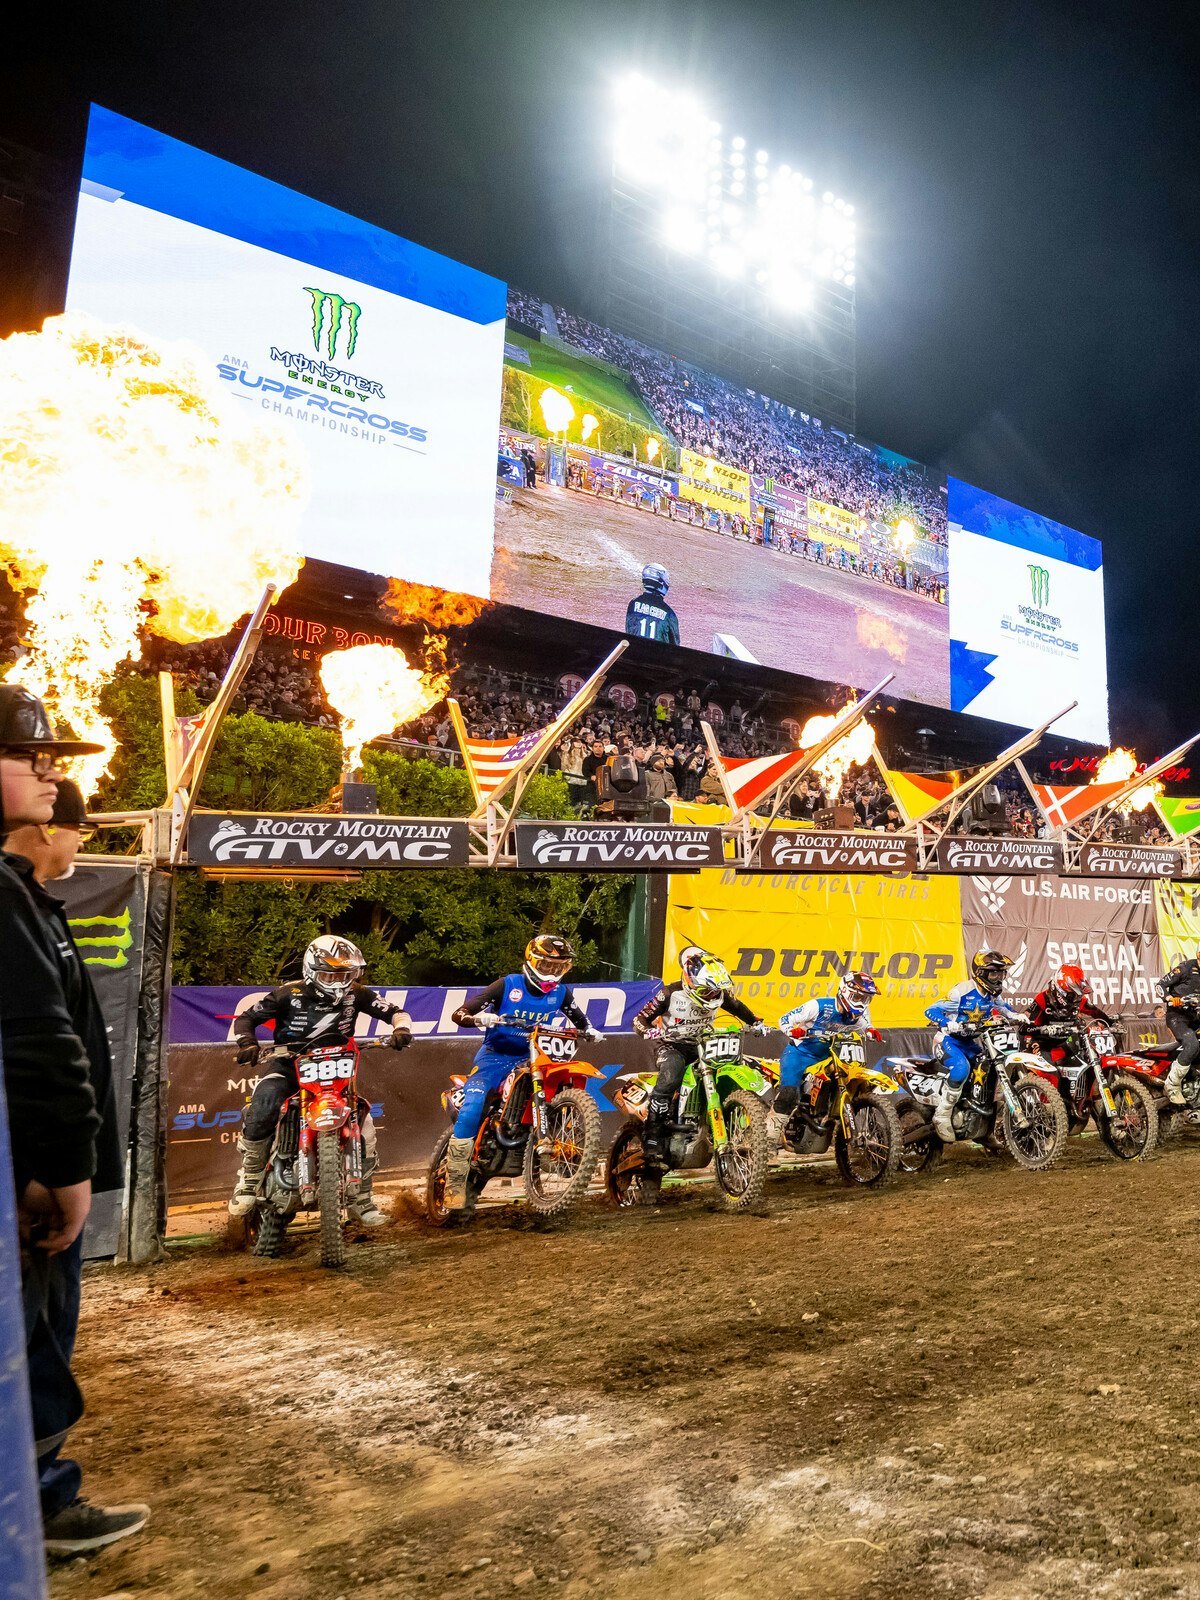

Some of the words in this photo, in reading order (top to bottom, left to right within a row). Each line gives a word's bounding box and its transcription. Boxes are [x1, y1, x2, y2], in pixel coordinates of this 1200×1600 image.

[222, 354, 249, 370] AMA
[288, 370, 370, 402] ENERGY
[216, 363, 428, 442] SUPERCROSS
[261, 398, 387, 445] CHAMPIONSHIP
[694, 459, 746, 482] DNLOP
[1001, 620, 1079, 652] SUPERCROSS
[251, 818, 331, 837] ROCKY
[334, 820, 452, 839] MOUNTAIN
[562, 827, 620, 842] ROCKY
[623, 827, 709, 842] MOUNTAIN
[794, 834, 838, 848] ROCKY
[839, 835, 907, 850] MOUNTAIN
[965, 840, 999, 852] ROCKY
[1000, 841, 1053, 854] MOUNTAIN
[1101, 847, 1129, 859] ROCKY
[1130, 849, 1174, 862] MOUNTAIN
[877, 881, 930, 900] TIRES
[1021, 879, 1056, 897] U.S.
[1060, 883, 1090, 900] AIR
[1094, 886, 1151, 904] FORCE
[731, 947, 954, 979] DUNLOP
[1047, 941, 1145, 972] SPECIAL
[731, 981, 834, 998] MOTORCY
[886, 983, 940, 998] TIRES
[538, 1036, 576, 1057] 604
[706, 1039, 740, 1059] 508
[994, 1033, 1018, 1050] 24
[1095, 1037, 1116, 1055] 84
[840, 1045, 864, 1062] 410
[300, 1058, 354, 1084] 388
[179, 1104, 206, 1114] AMA
